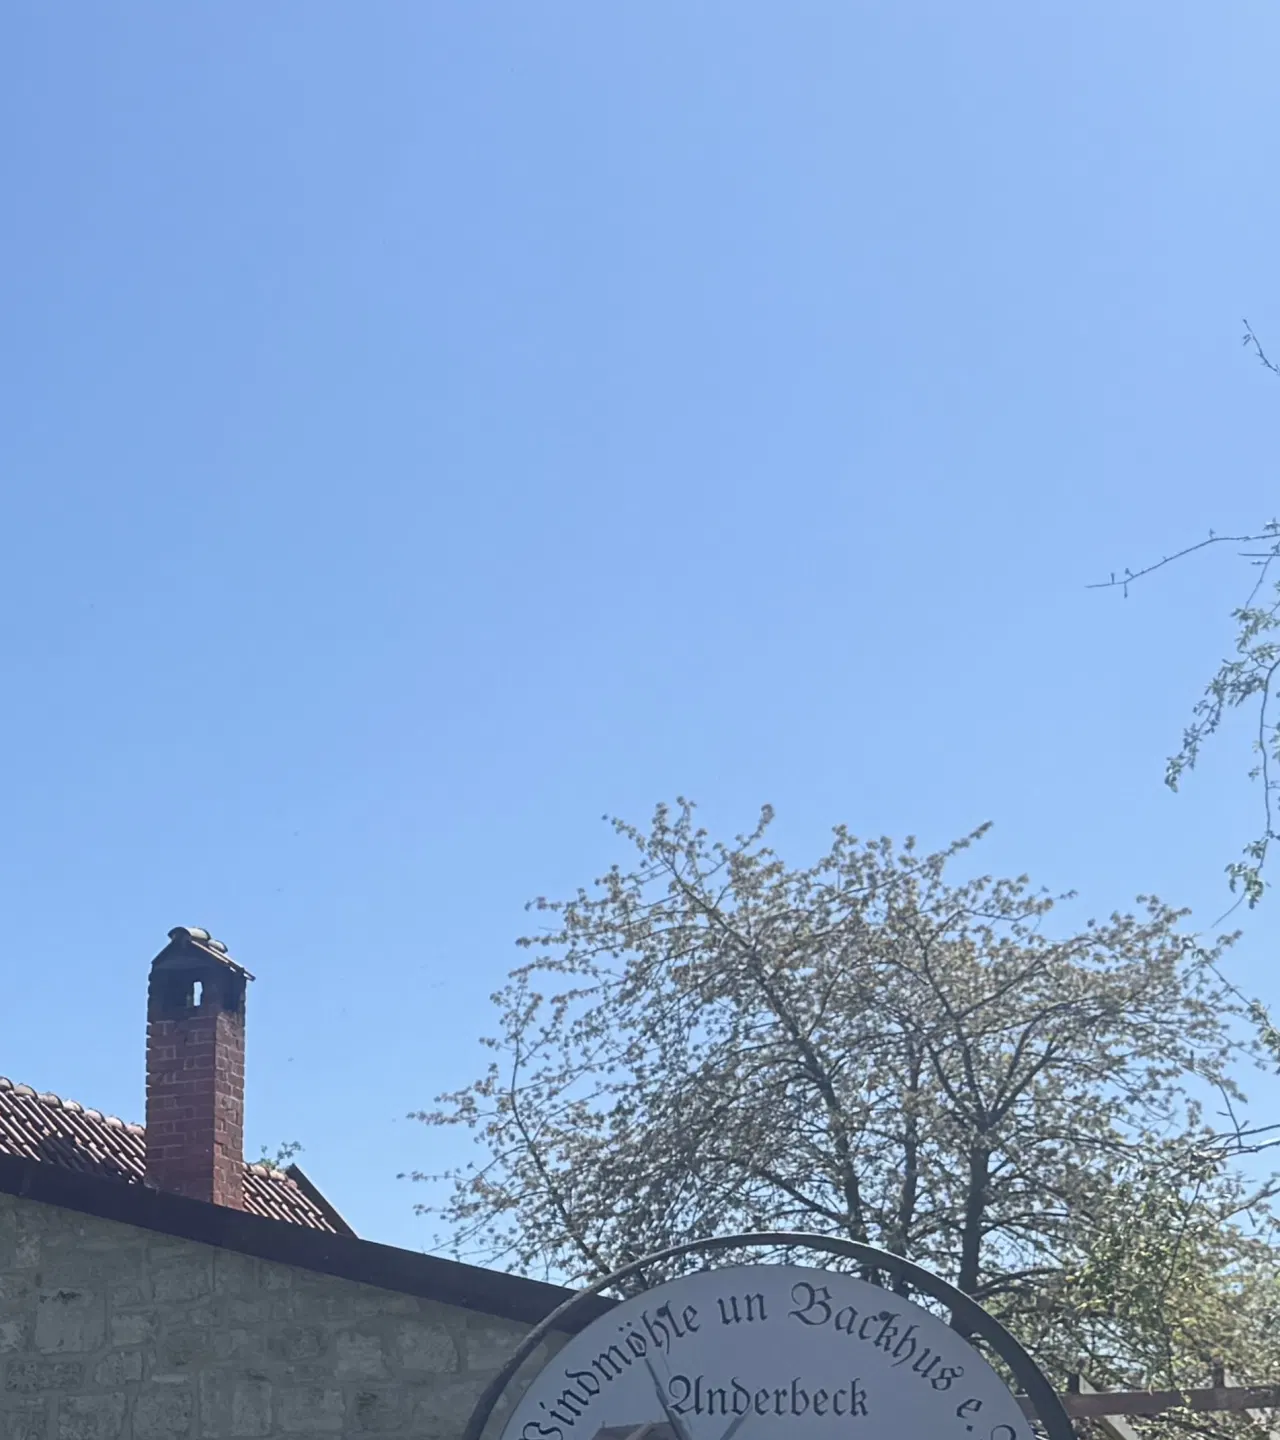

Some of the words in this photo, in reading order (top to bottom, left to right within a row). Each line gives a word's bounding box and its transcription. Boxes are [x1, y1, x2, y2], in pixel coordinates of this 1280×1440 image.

[668, 1374, 869, 1417] Anderbeck
[717, 1292, 768, 1325] un
[788, 1281, 965, 1391] Backhus
[956, 1398, 983, 1432] e.
